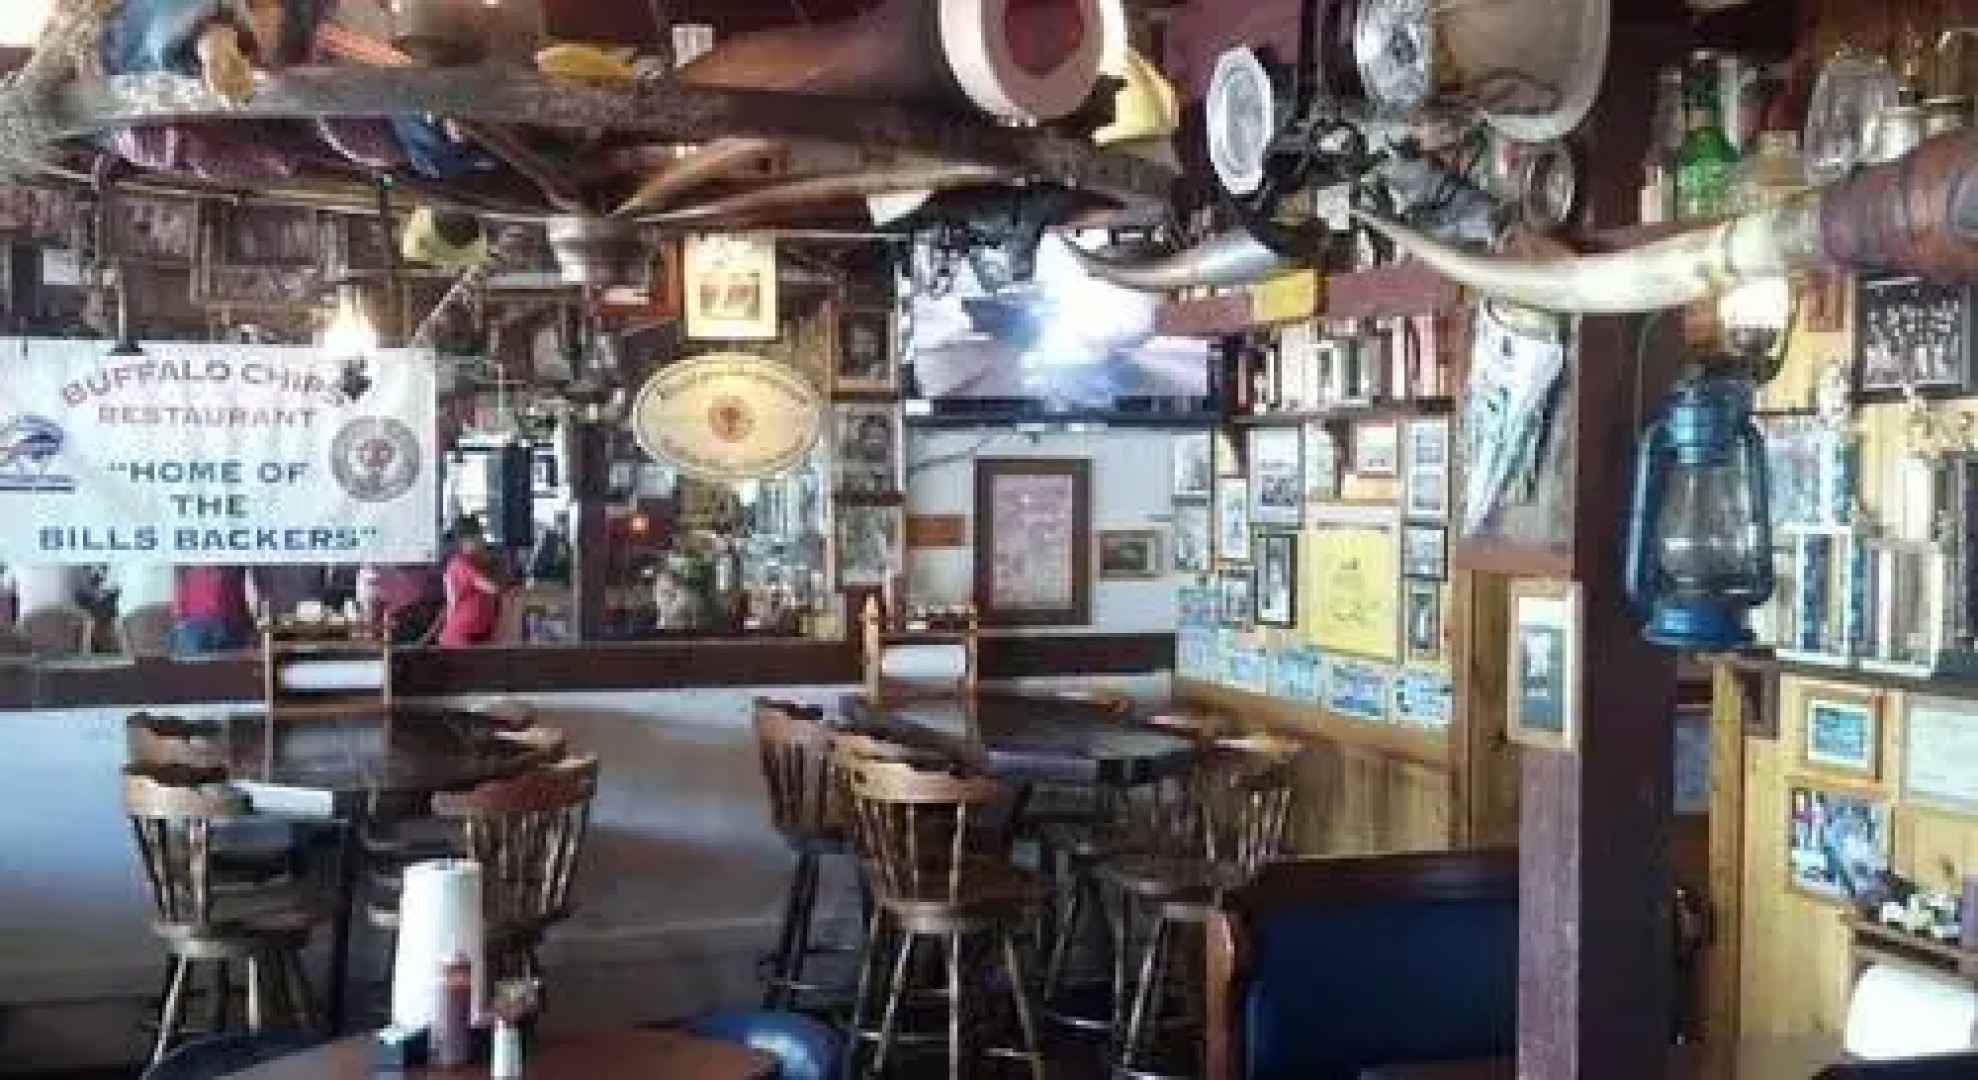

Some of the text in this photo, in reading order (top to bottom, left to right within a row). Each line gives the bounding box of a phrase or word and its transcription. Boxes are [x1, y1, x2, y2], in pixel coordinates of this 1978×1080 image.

[62, 359, 231, 406] BUFFALO
[98, 406, 316, 427] RESTAURANT
[257, 462, 308, 483] OF
[170, 494, 248, 517] THE
[39, 526, 158, 550] BILLS
